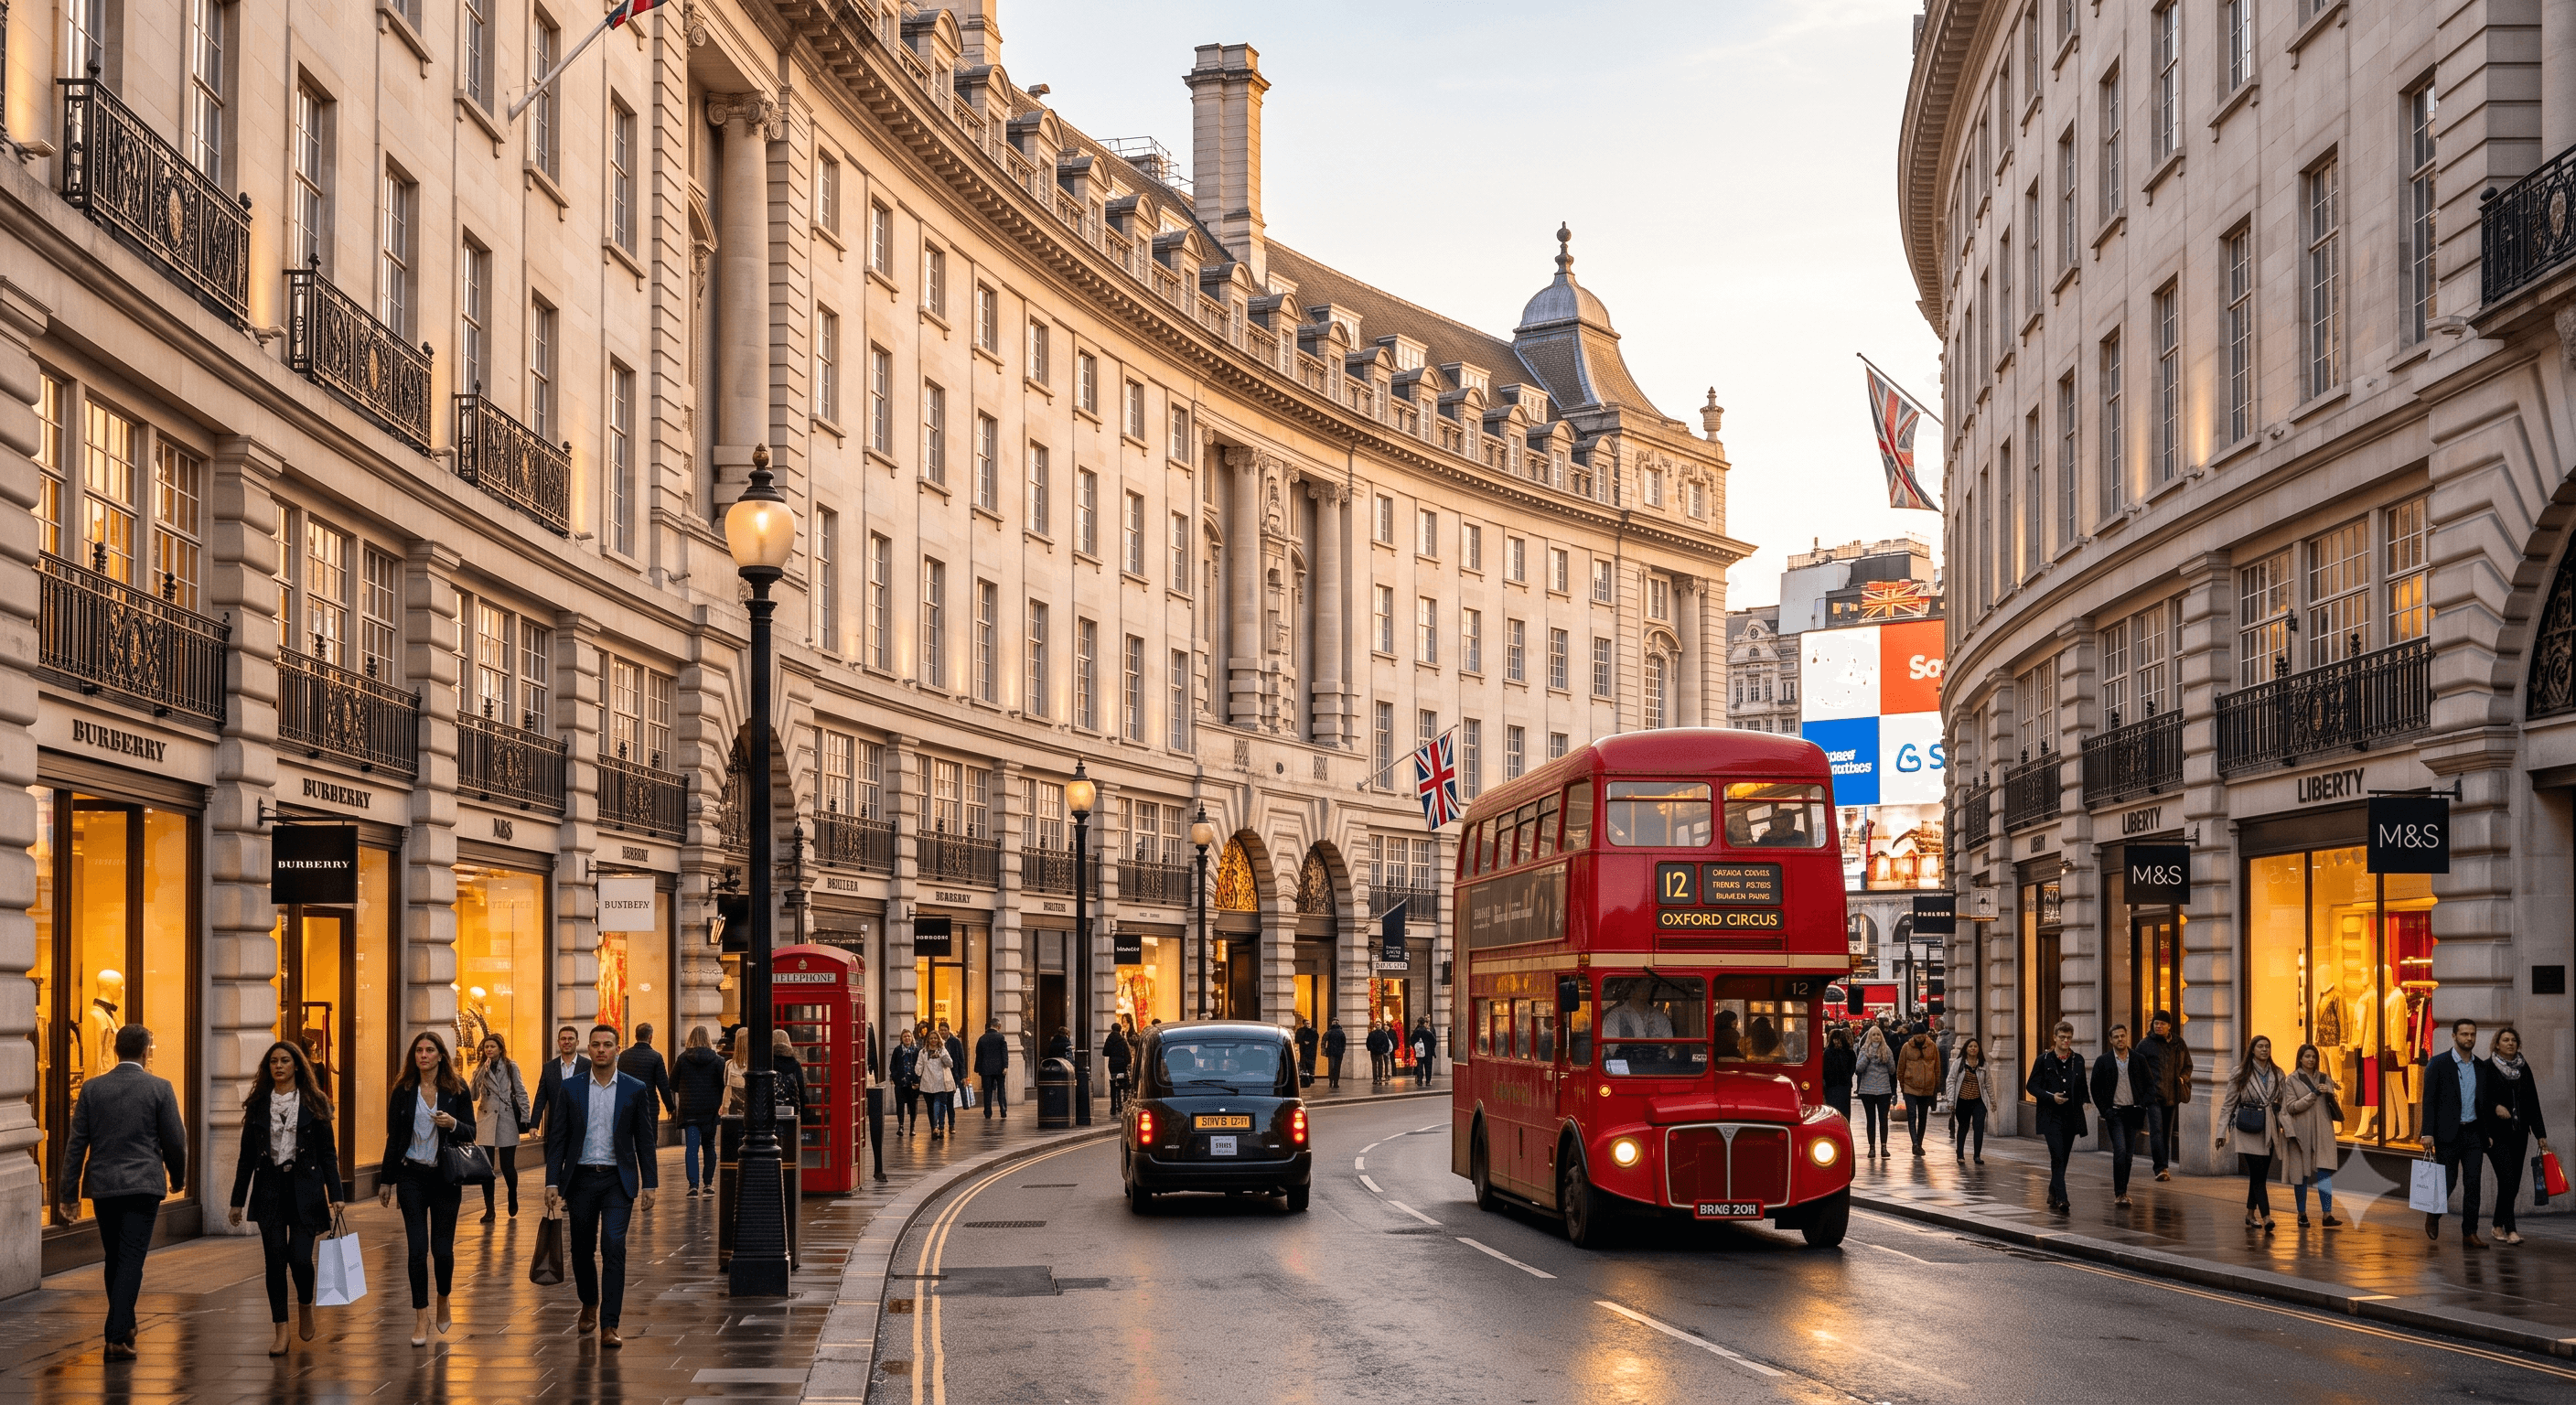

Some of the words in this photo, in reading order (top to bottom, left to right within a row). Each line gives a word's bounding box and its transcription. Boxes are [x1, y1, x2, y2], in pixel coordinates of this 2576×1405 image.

[73, 719, 167, 762] BURBERRY
[303, 778, 371, 809] BURBERRY
[2298, 767, 2365, 803] LIBERTY
[2122, 806, 2161, 835] LIBERTY
[2379, 823, 2440, 848] M&S
[278, 861, 349, 869] BURBERRY
[2133, 864, 2182, 885] M&S
[1666, 871, 1688, 897] 12
[1662, 913, 1722, 926] OXFORD
[1726, 913, 1777, 926] CIRCUS
[774, 973, 834, 981] TELEPHONE
[1792, 982, 1809, 994] 12
[1700, 1204, 1730, 1215] BRNG
